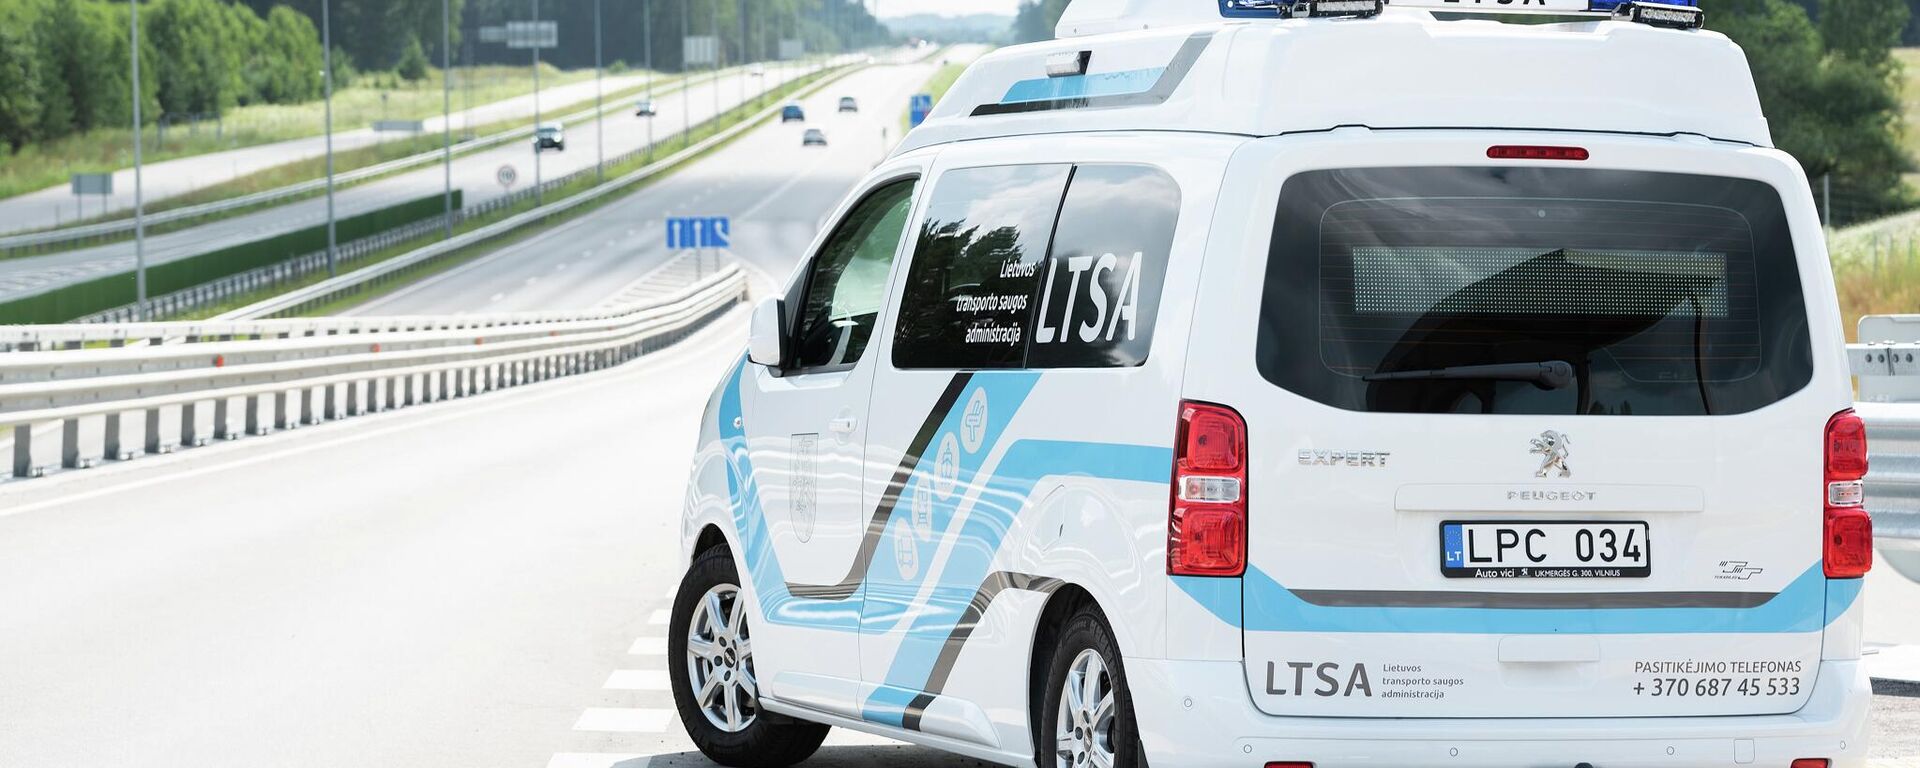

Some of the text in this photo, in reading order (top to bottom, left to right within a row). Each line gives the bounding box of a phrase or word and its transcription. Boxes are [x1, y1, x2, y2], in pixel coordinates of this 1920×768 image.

[1000, 259, 1036, 278] Lietuvos
[956, 293, 1028, 315] transporto saugos
[1035, 252, 1143, 343] LTSA
[965, 322, 1021, 347] administracija
[1298, 448, 1391, 467] EXPERT
[1507, 490, 1597, 501] PEUGEOT
[1468, 528, 1641, 563] LPC 034
[1446, 551, 1462, 562] LT
[1475, 568, 1515, 578] Auto vici
[1595, 569, 1621, 577] VILNIUS
[1383, 664, 1422, 673] Lietuvos
[1635, 659, 1802, 674] PASITIKĖJIMO TELEFONAS
[1266, 660, 1372, 697] LTSA
[1382, 677, 1464, 687] transporto saugos
[1651, 678, 1689, 697] 370
[1695, 678, 1732, 697] 687
[1737, 678, 1761, 697] 45
[1766, 677, 1800, 696] 533
[1381, 690, 1445, 699] administracija
